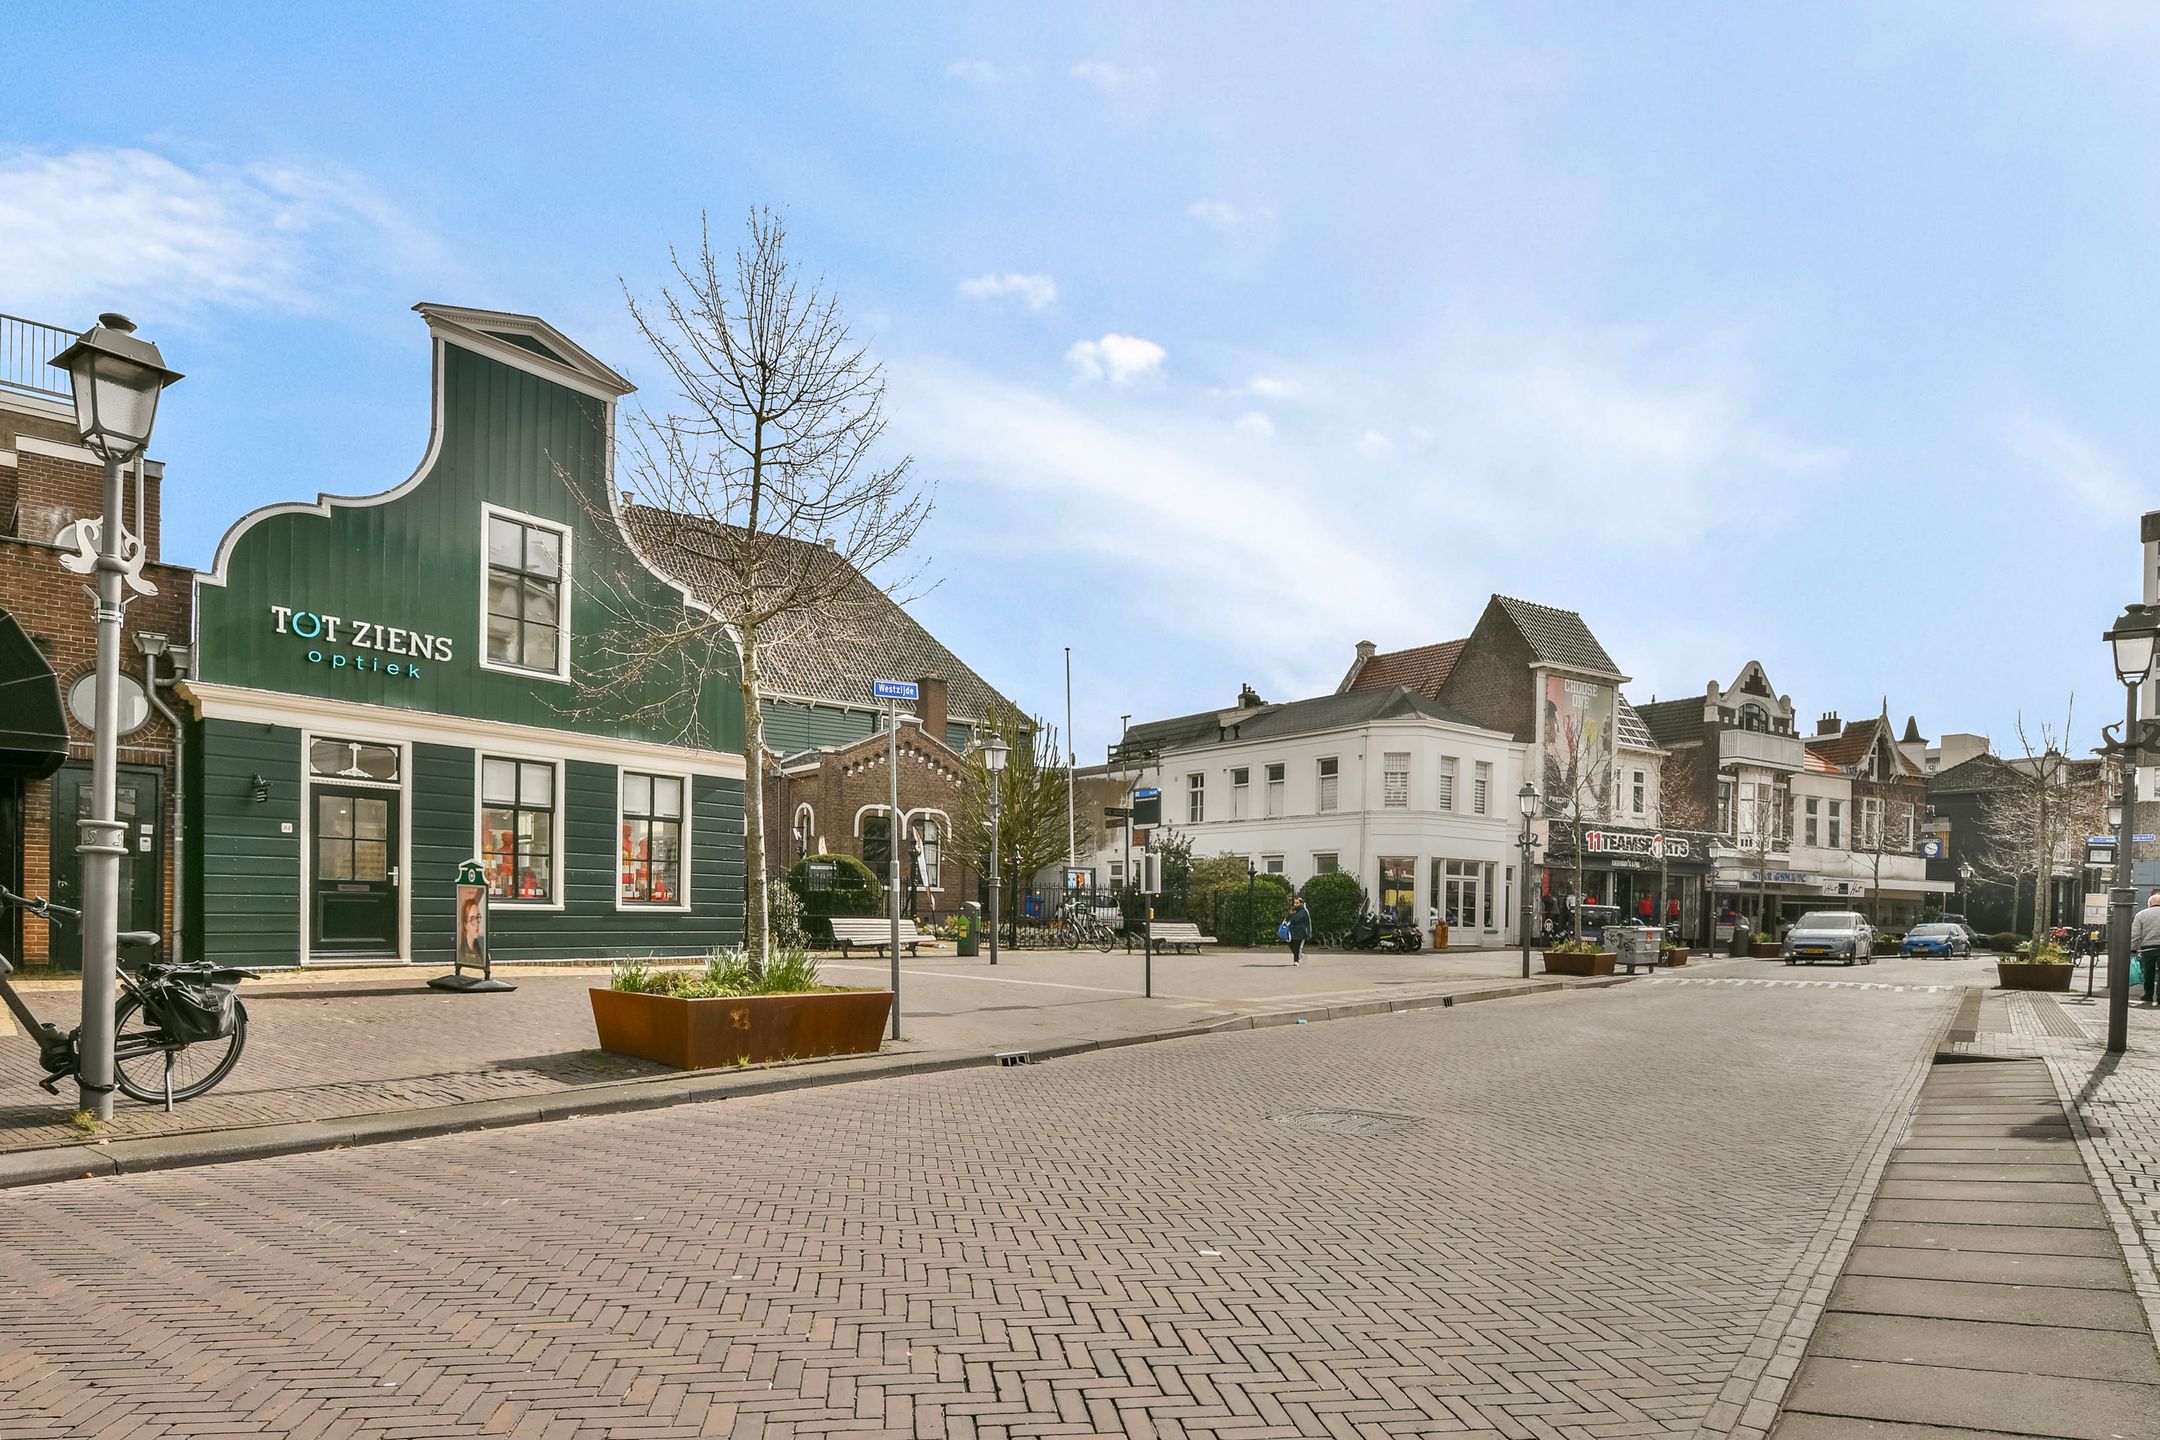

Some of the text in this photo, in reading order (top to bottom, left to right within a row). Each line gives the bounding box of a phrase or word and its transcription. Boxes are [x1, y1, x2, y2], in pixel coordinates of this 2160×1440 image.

[271, 605, 453, 662] TOT ZIENS
[308, 650, 420, 679] optiek
[878, 684, 915, 696] Westzijde
[1564, 680, 1598, 697] CHOOSE
[1572, 694, 1590, 709] ONE
